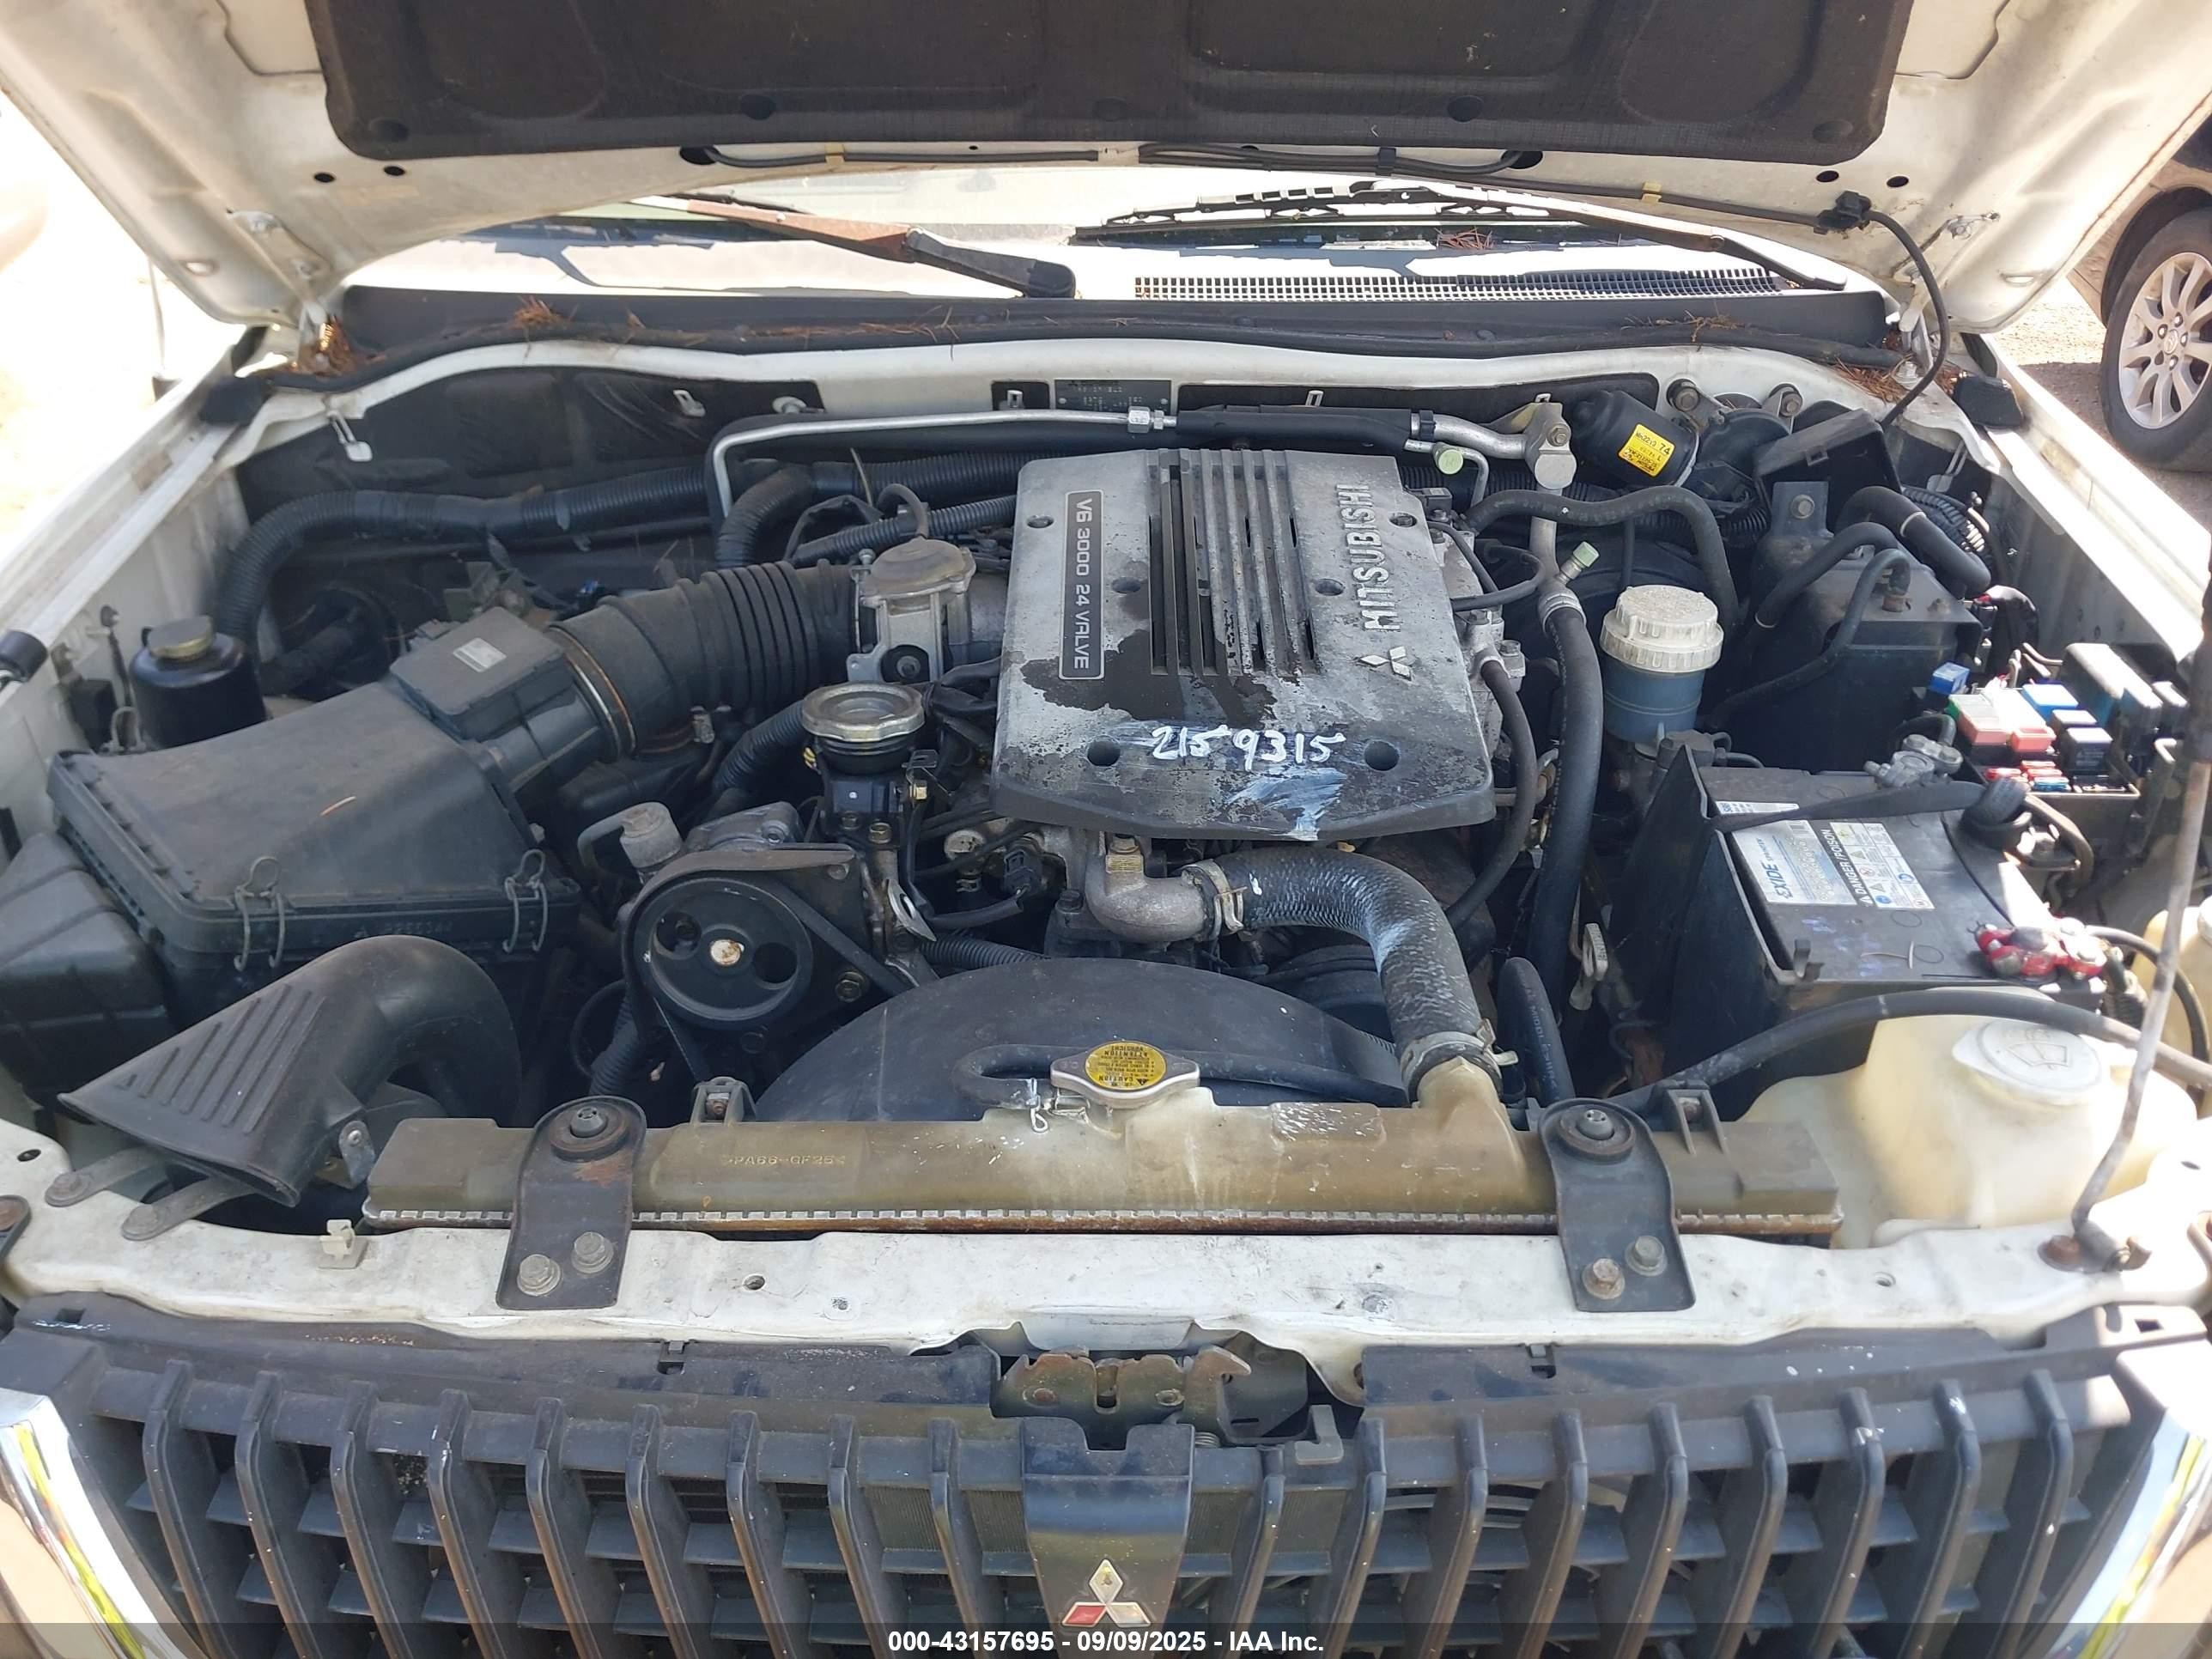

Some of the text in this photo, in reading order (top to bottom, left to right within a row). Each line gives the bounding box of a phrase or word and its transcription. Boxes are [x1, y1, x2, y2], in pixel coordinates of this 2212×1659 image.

[1073, 498, 1092, 669] V6 3000 24 VALVE
[1336, 484, 1401, 630] MITSUBISHI
[1839, 864, 1867, 895] DANGER
